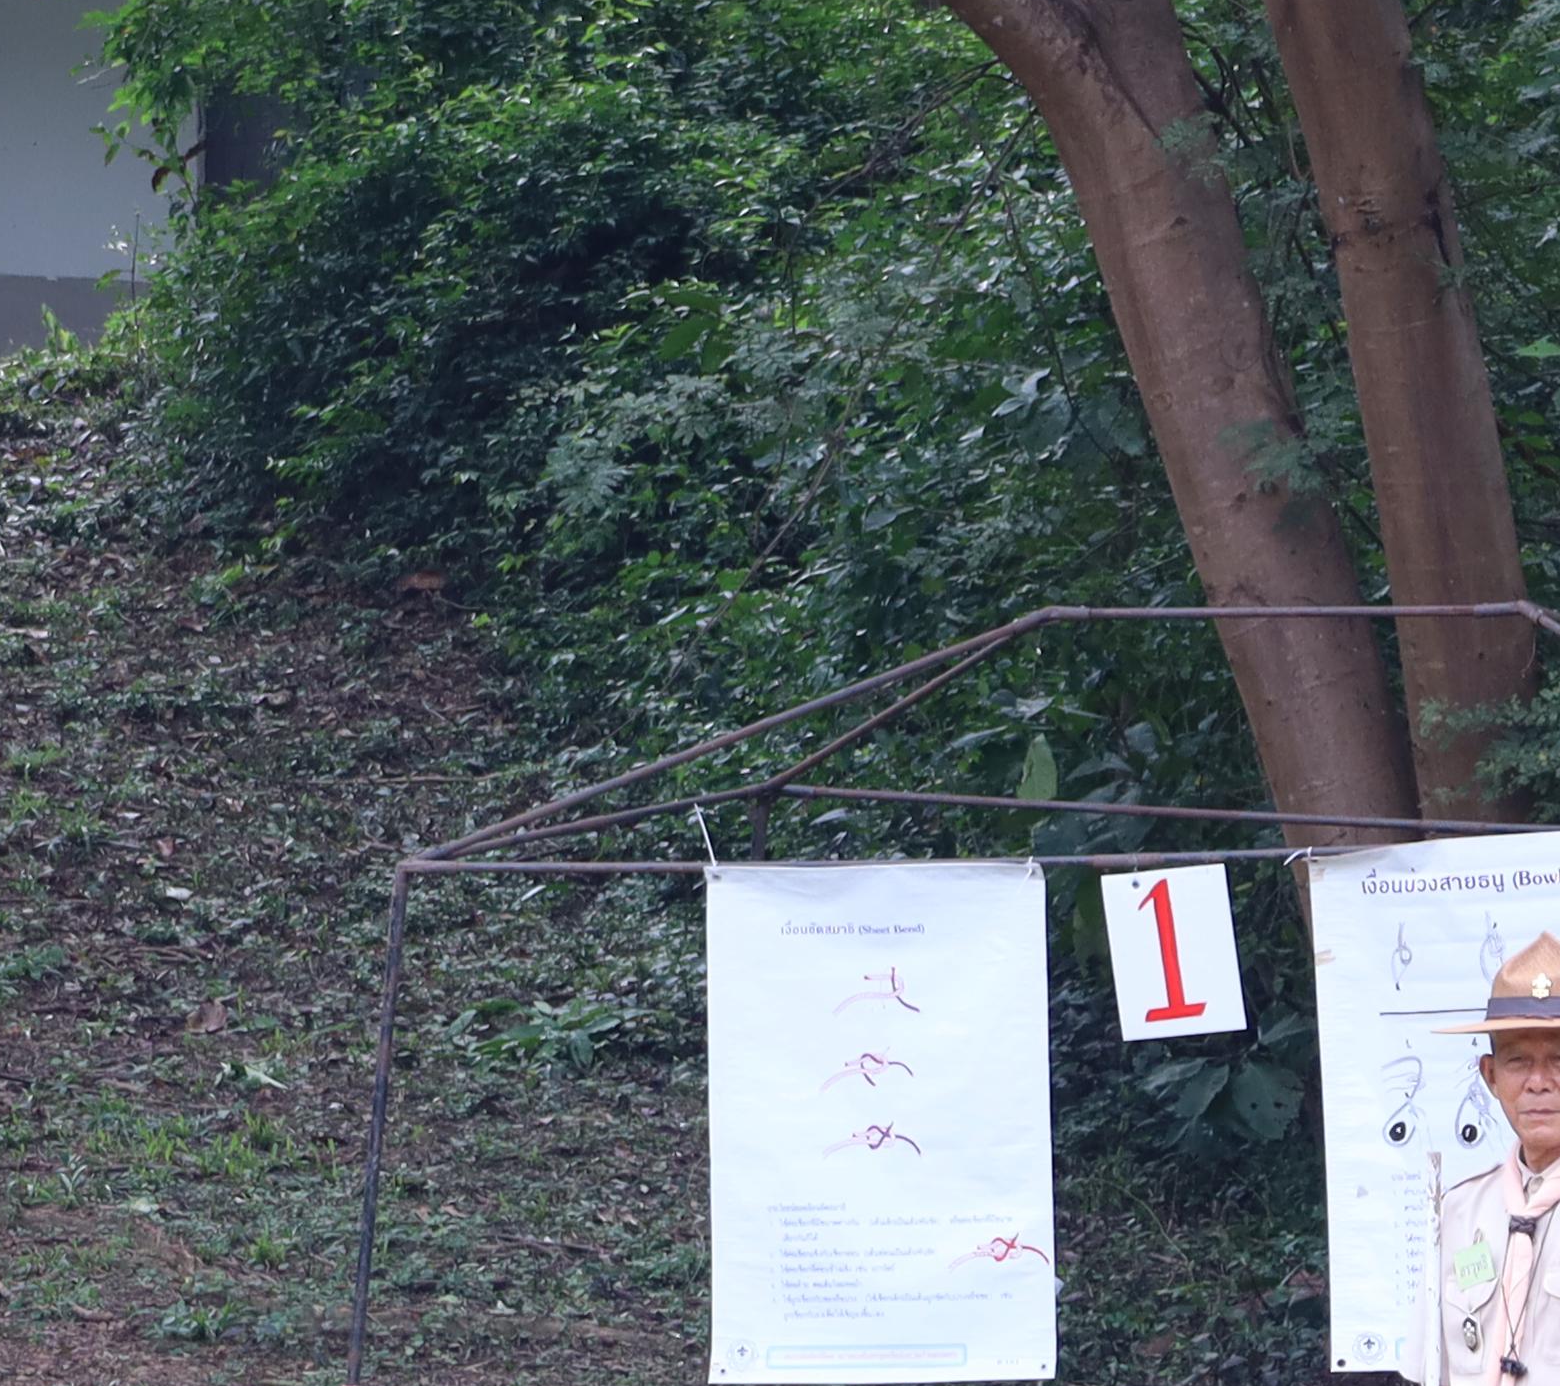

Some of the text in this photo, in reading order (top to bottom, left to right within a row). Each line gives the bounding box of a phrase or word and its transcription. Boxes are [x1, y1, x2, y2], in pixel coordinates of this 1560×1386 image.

[1361, 868, 1505, 894] เงื่อนบ่วงสายธนู
[1138, 878, 1207, 1022] 1
